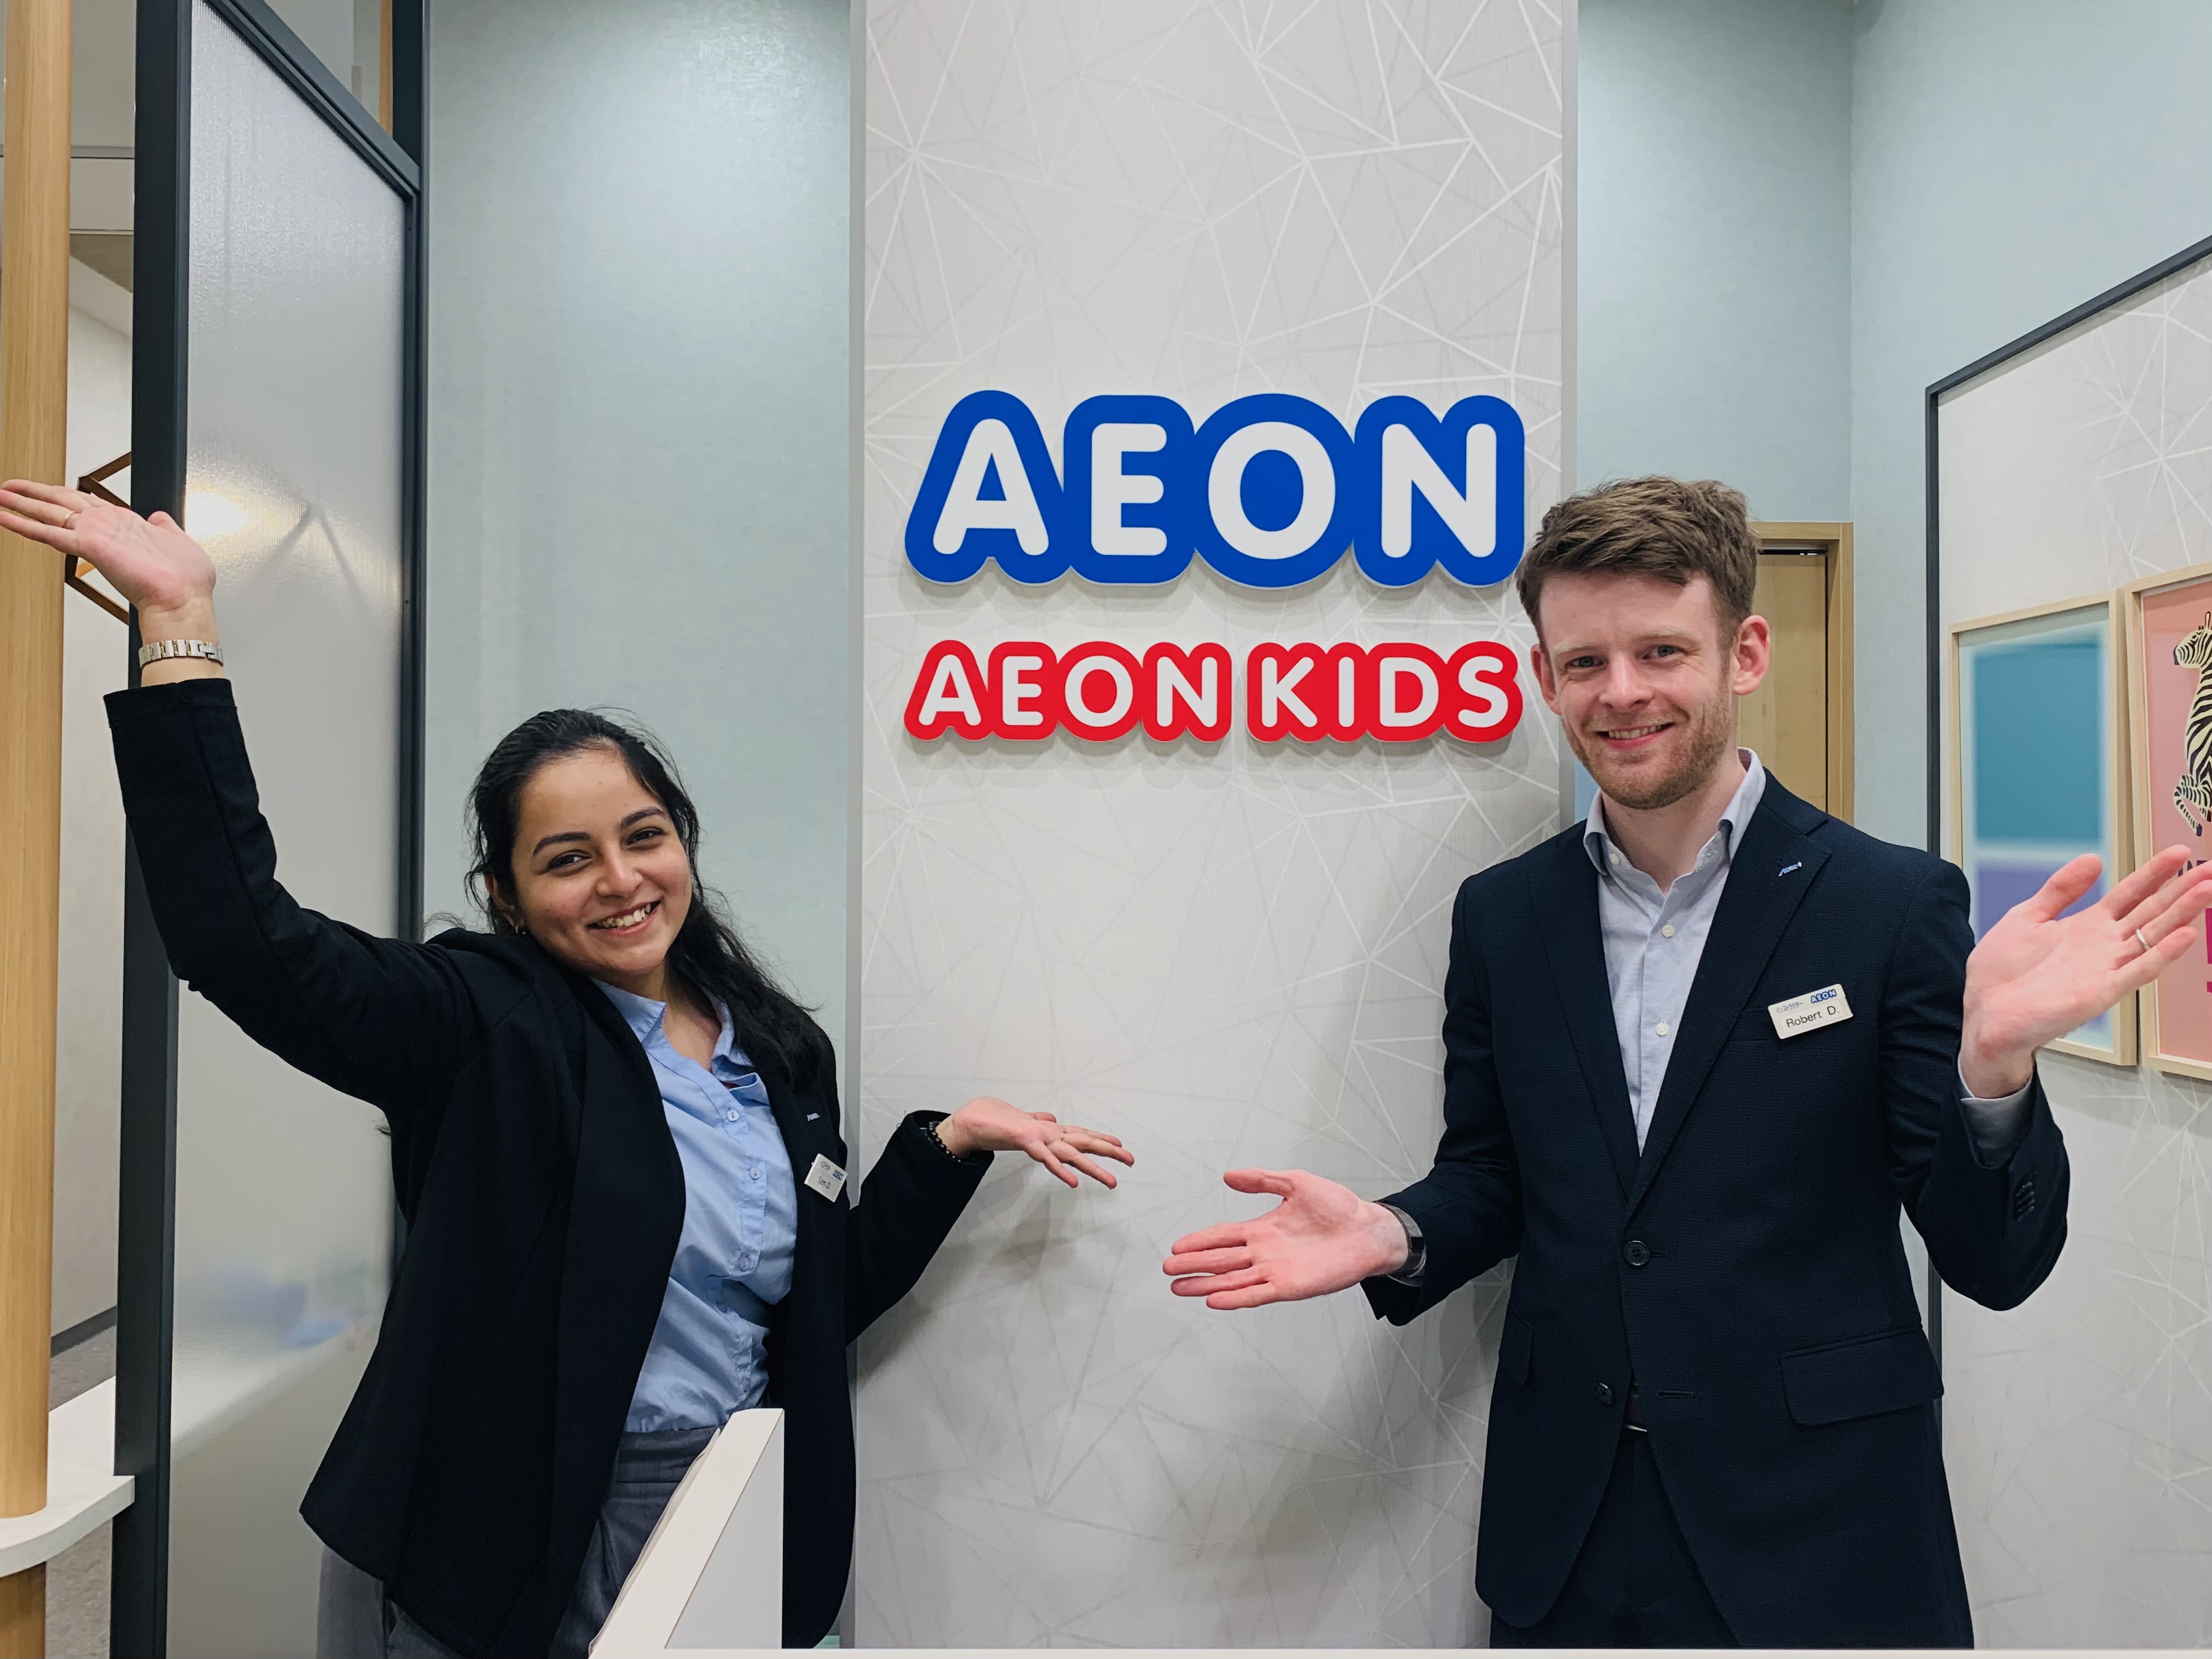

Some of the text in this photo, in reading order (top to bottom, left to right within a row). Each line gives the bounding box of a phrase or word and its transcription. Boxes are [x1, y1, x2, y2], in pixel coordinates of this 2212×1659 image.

[905, 390, 1525, 587] AEON
[904, 640, 1523, 742] AEON KIDS
[1786, 1006, 1839, 1028] Robert D.
[1811, 989, 1837, 1003] AEON
